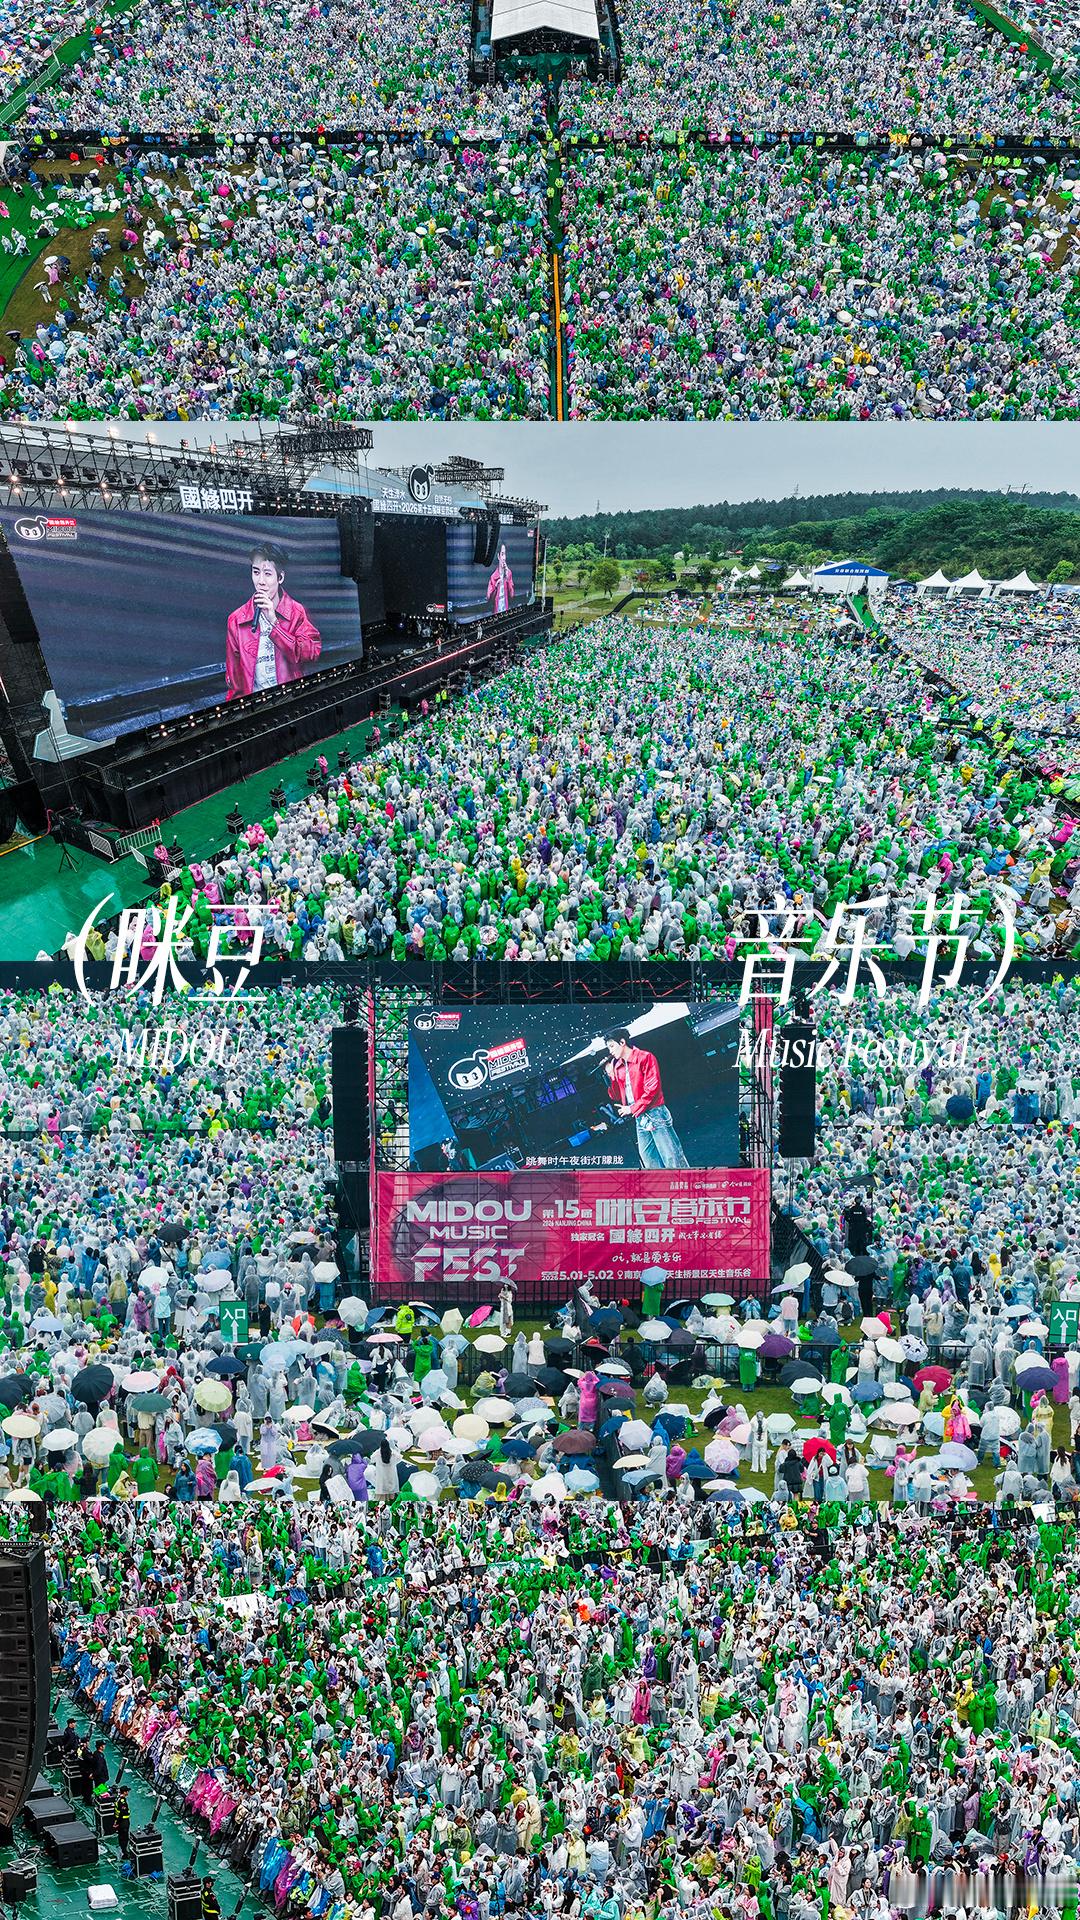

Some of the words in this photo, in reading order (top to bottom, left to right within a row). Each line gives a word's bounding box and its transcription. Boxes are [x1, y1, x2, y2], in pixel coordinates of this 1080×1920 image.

[179, 485, 253, 511] 國緣四开
[488, 1049, 527, 1068] MIDOU
[406, 1200, 532, 1222] MIDOU
[429, 1225, 508, 1240] MUSIC
[609, 1228, 676, 1244] 國緣四开
[411, 1242, 530, 1282] FEST
[559, 1271, 614, 1281] 5.01-5.02
[222, 1308, 246, 1320] 入口
[1053, 1308, 1077, 1321] 入口
